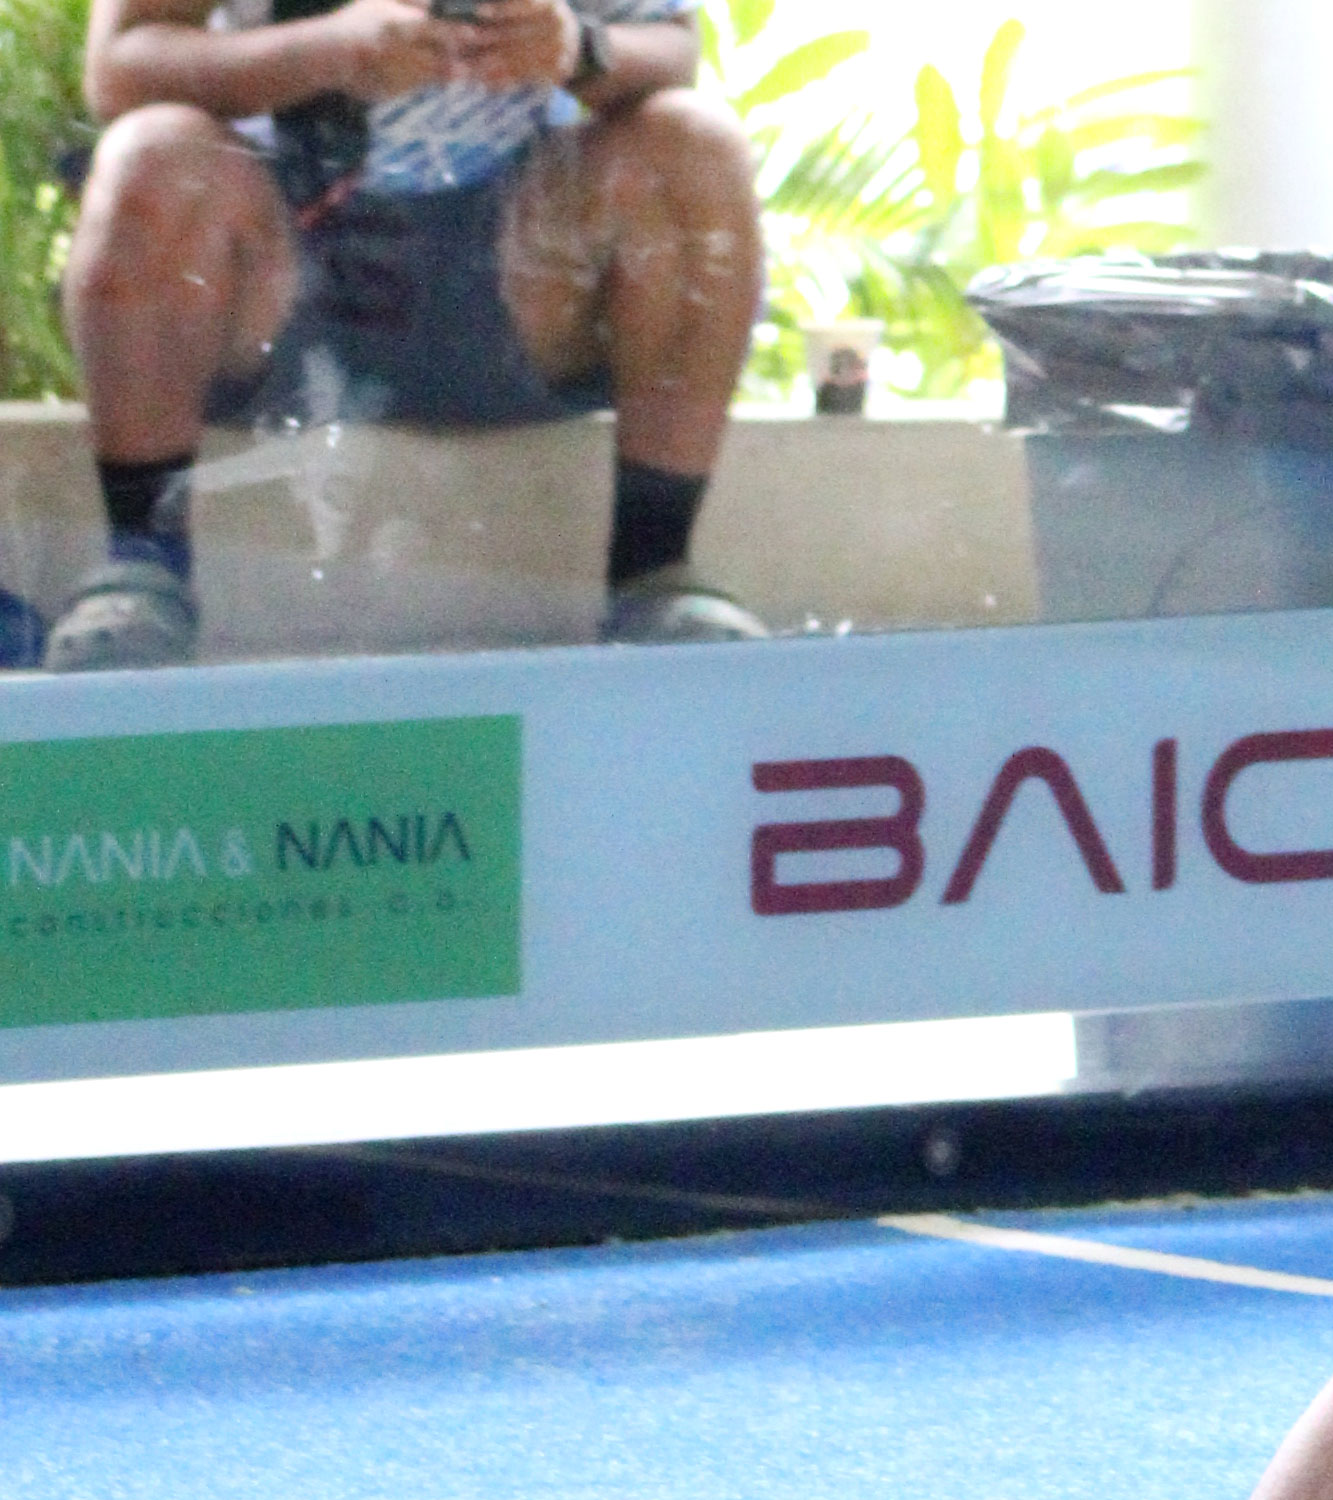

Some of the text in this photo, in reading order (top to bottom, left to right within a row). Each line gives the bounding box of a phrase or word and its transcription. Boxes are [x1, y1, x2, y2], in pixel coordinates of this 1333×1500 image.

[10, 811, 471, 886] NANIA & NANIA
